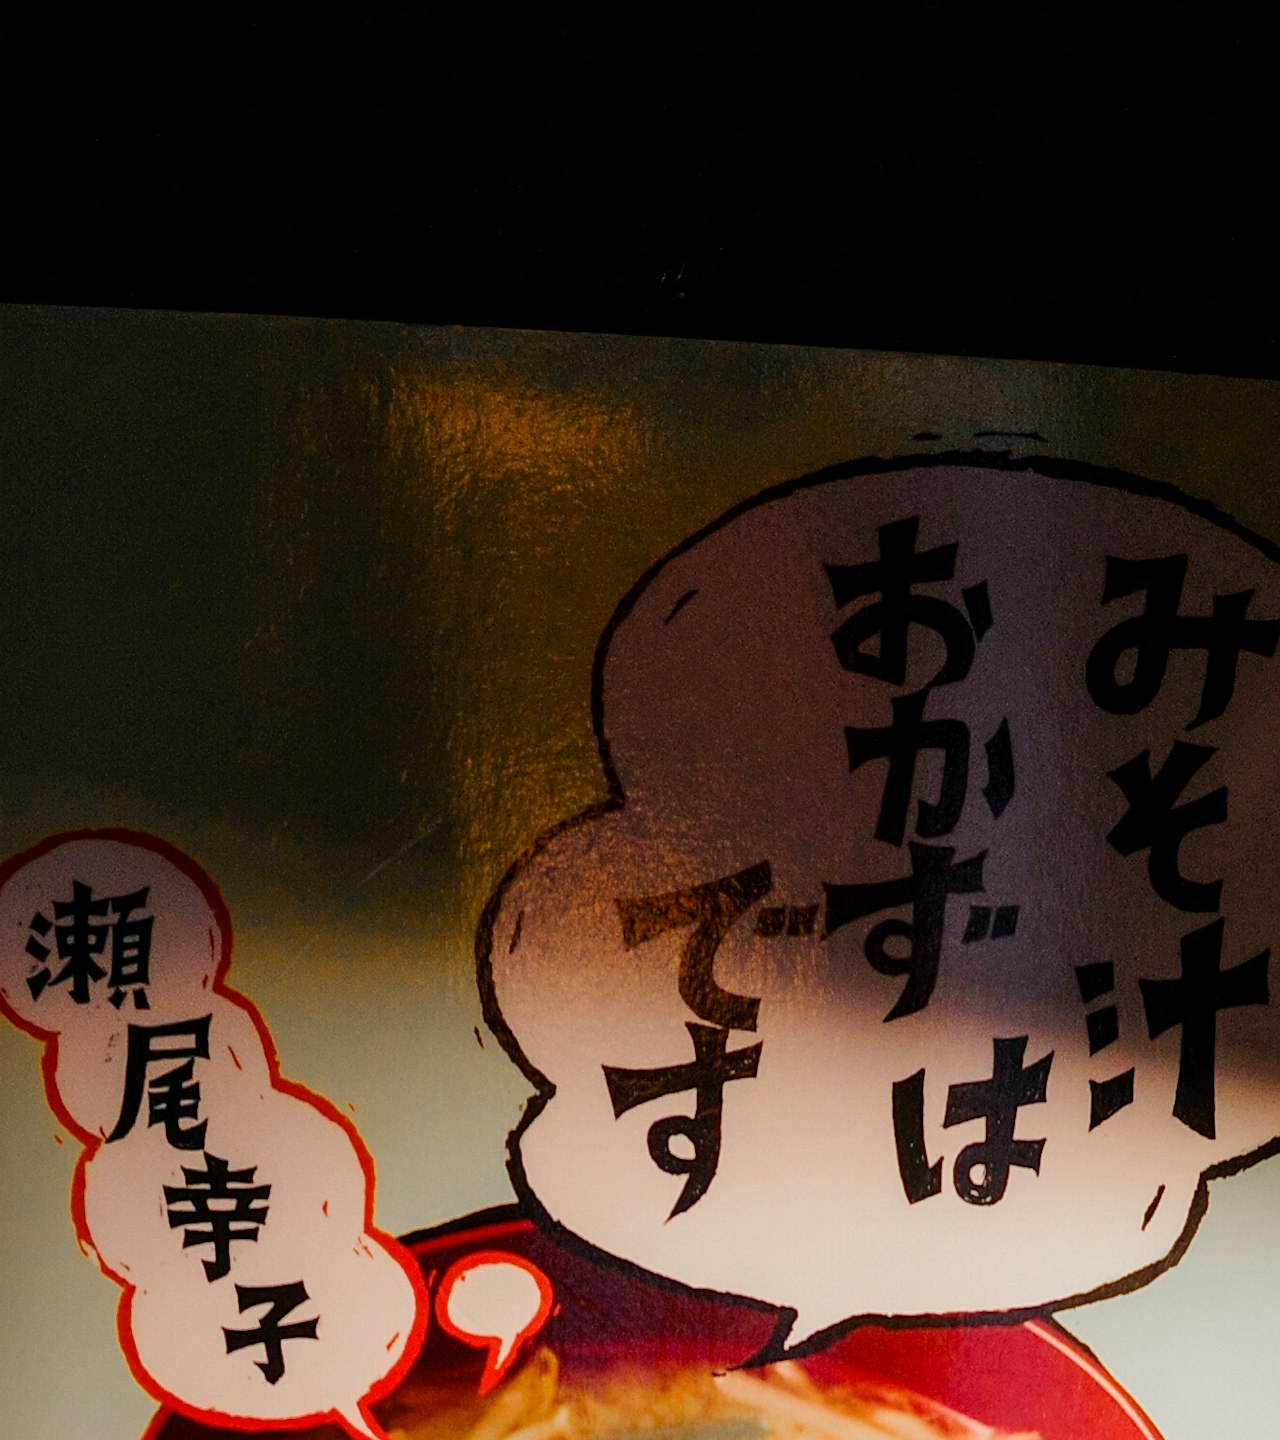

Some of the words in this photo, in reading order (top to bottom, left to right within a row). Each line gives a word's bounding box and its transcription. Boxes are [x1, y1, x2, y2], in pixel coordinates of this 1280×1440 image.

[602, 860, 820, 1225] です
[820, 515, 1056, 1205] おかずは
[23, 880, 320, 1385] 瀬尾幸子
